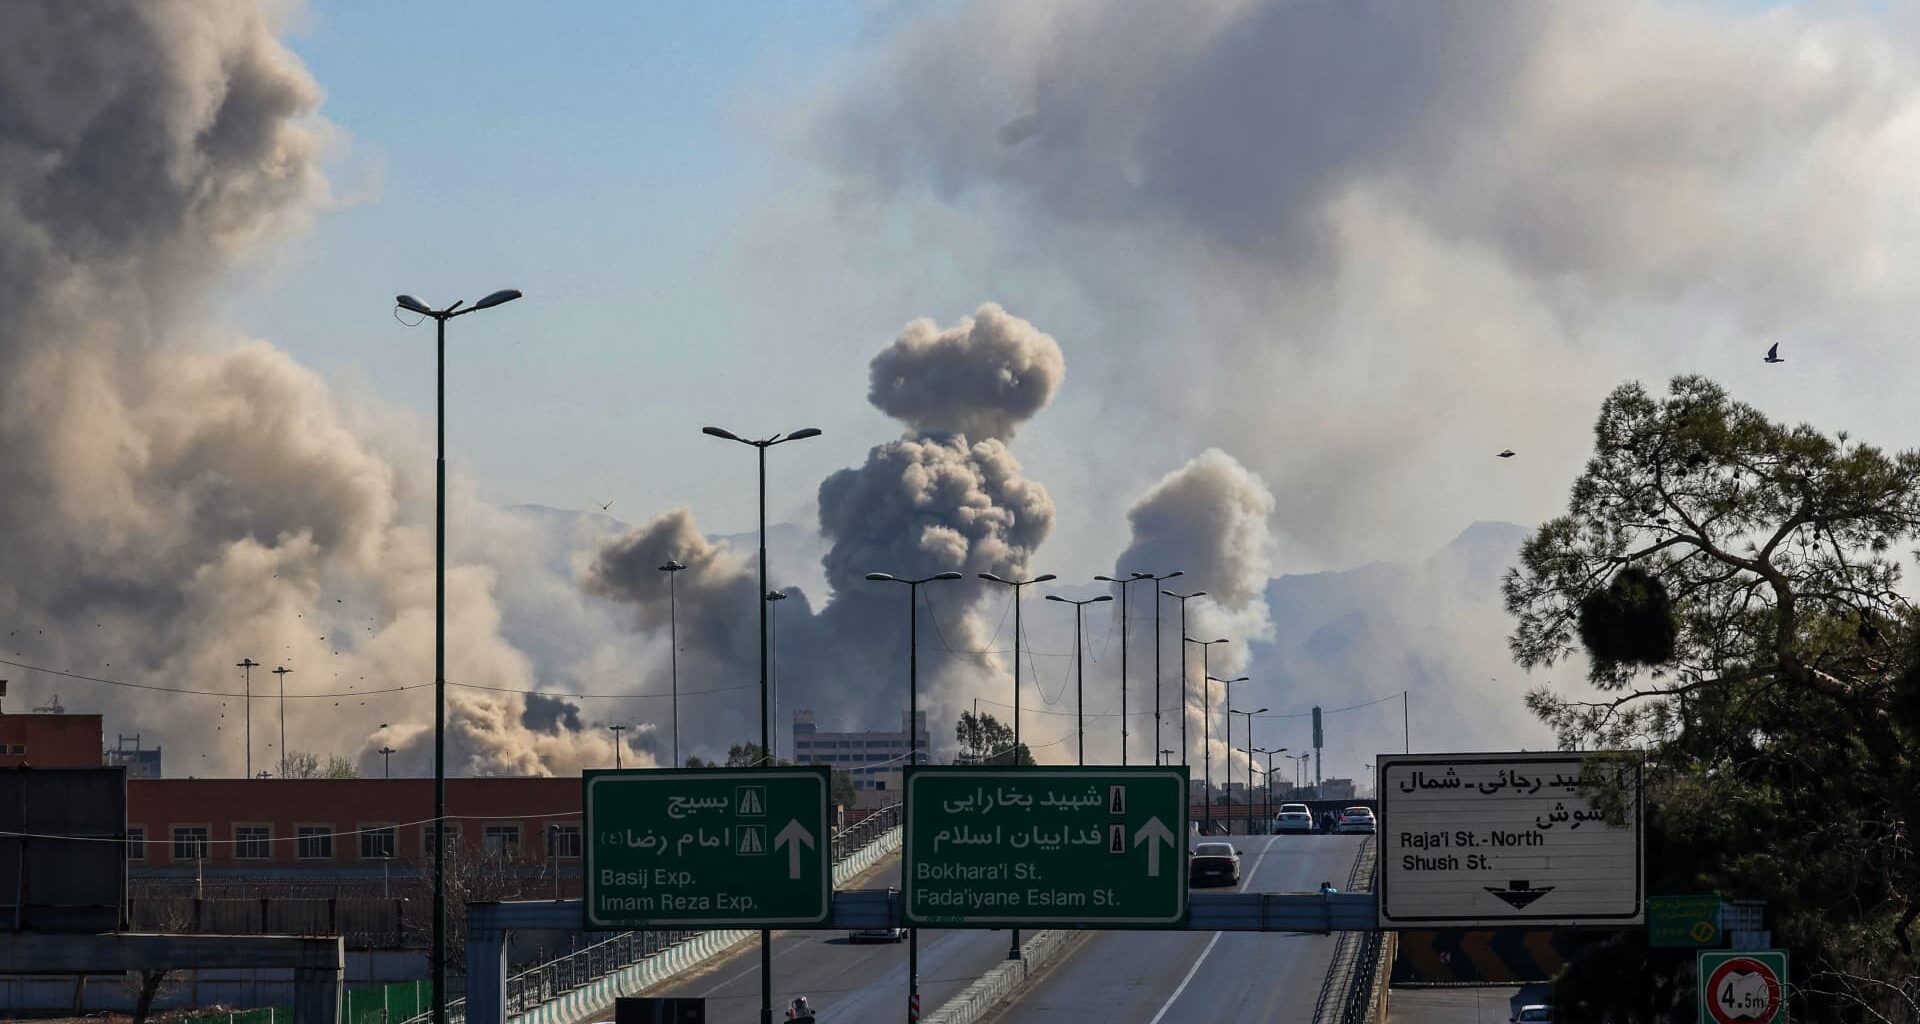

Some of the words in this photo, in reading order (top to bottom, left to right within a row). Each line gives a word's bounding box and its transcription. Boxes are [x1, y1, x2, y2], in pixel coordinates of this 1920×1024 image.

[667, 795, 729, 819] بسیج
[943, 786, 1033, 814] بخارایی
[1039, 785, 1102, 811] شهید
[677, 828, 729, 857] امام
[933, 824, 1001, 853] اسلام
[1010, 824, 1101, 850] فداییان
[1400, 832, 1449, 850] Raja'i
[916, 862, 1008, 880] Bokhara'i
[1014, 862, 1042, 880] St.
[1402, 854, 1459, 871] Shush
[1466, 854, 1493, 871] St.
[601, 868, 648, 889] Basij
[655, 868, 696, 888] Exp.
[601, 894, 655, 912] Imam
[661, 893, 710, 911] Reza
[716, 892, 759, 912] Exp.
[916, 888, 1021, 908] Fada'iyane
[1027, 888, 1086, 907] Eslam
[1092, 887, 1121, 906] St.
